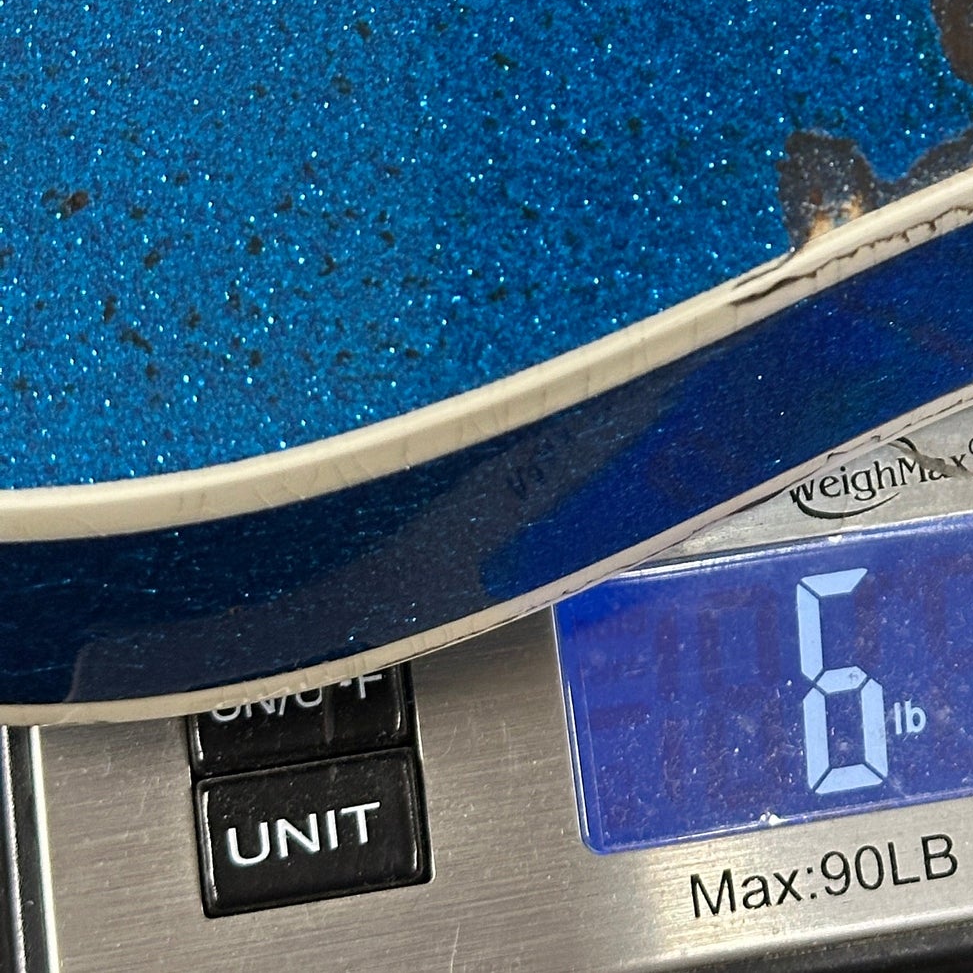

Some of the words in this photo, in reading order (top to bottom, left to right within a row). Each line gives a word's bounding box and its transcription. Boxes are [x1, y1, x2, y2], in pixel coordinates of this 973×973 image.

[797, 567, 888, 794] 6
[893, 700, 926, 735] lb
[226, 801, 381, 867] UNIT
[689, 832, 959, 919] Max:90LB
